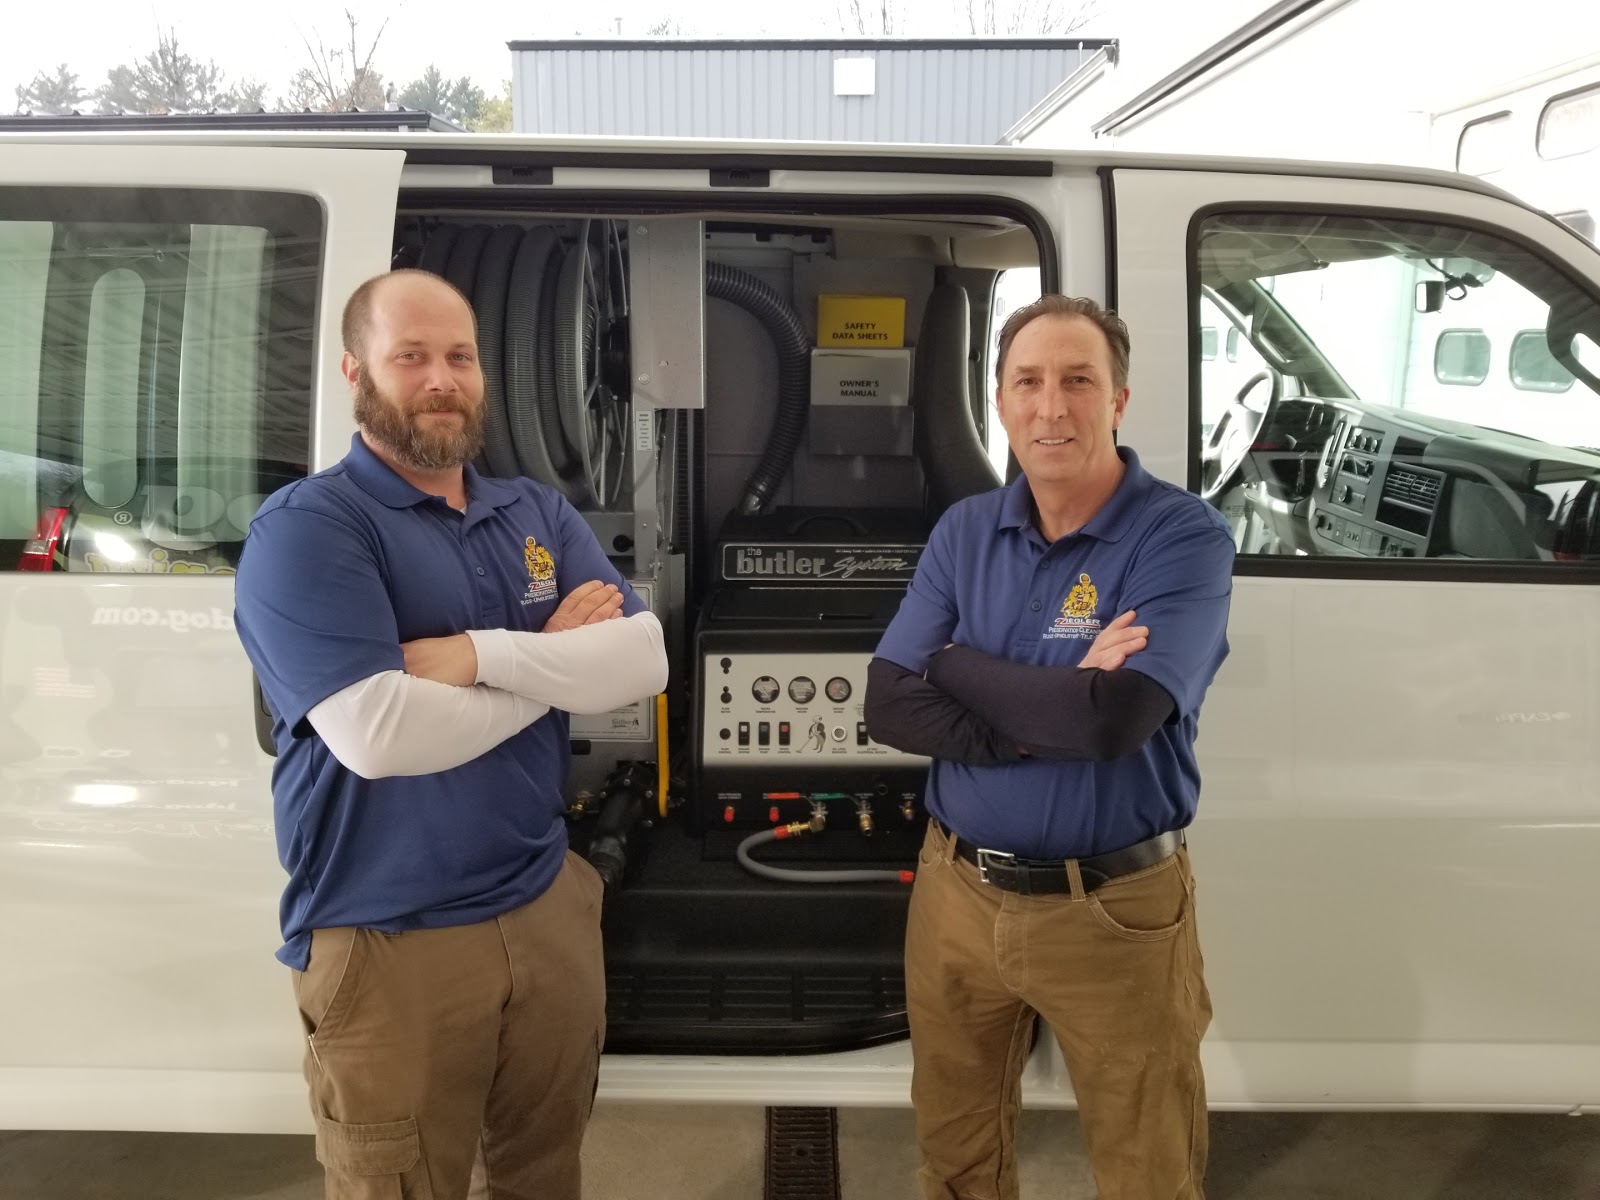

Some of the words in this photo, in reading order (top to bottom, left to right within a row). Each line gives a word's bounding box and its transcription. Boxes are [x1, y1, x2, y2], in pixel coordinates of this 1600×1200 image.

[845, 322, 876, 330] SAFETY
[832, 332, 854, 340] DATA
[857, 333, 888, 341] SHEETS
[839, 380, 879, 388] OWNER'S
[747, 547, 762, 556] the
[736, 550, 825, 575] butler
[818, 556, 916, 578] System
[1055, 617, 1101, 628] ZIEGLER
